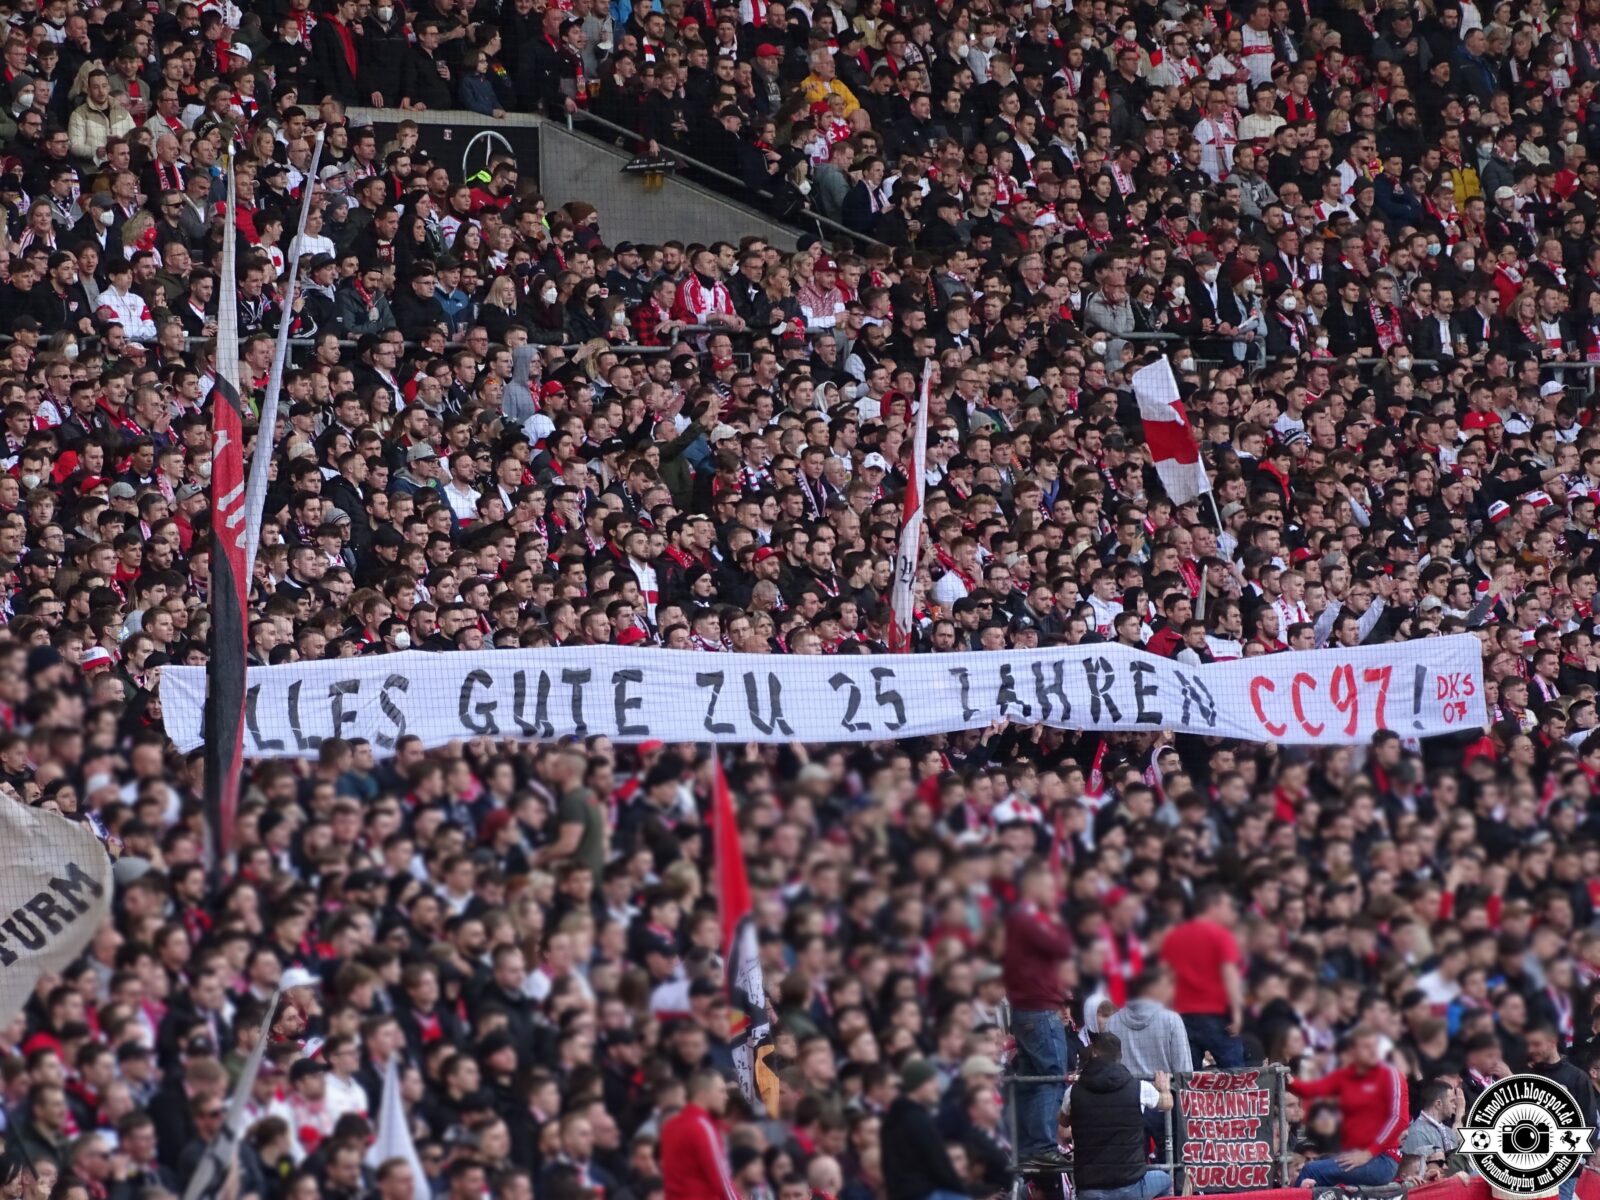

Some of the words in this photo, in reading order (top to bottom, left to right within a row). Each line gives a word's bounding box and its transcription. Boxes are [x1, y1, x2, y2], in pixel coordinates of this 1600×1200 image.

[1437, 672, 1476, 700] DKS
[202, 673, 410, 751] LLES
[459, 668, 649, 738] GUTE
[696, 670, 794, 736] ZU
[828, 667, 907, 732] 25
[1443, 701, 1467, 724] 07
[1188, 1070, 1260, 1091] JEDER
[1180, 1089, 1271, 1118] VERBANNTE
[1187, 1119, 1261, 1140] KEHRT
